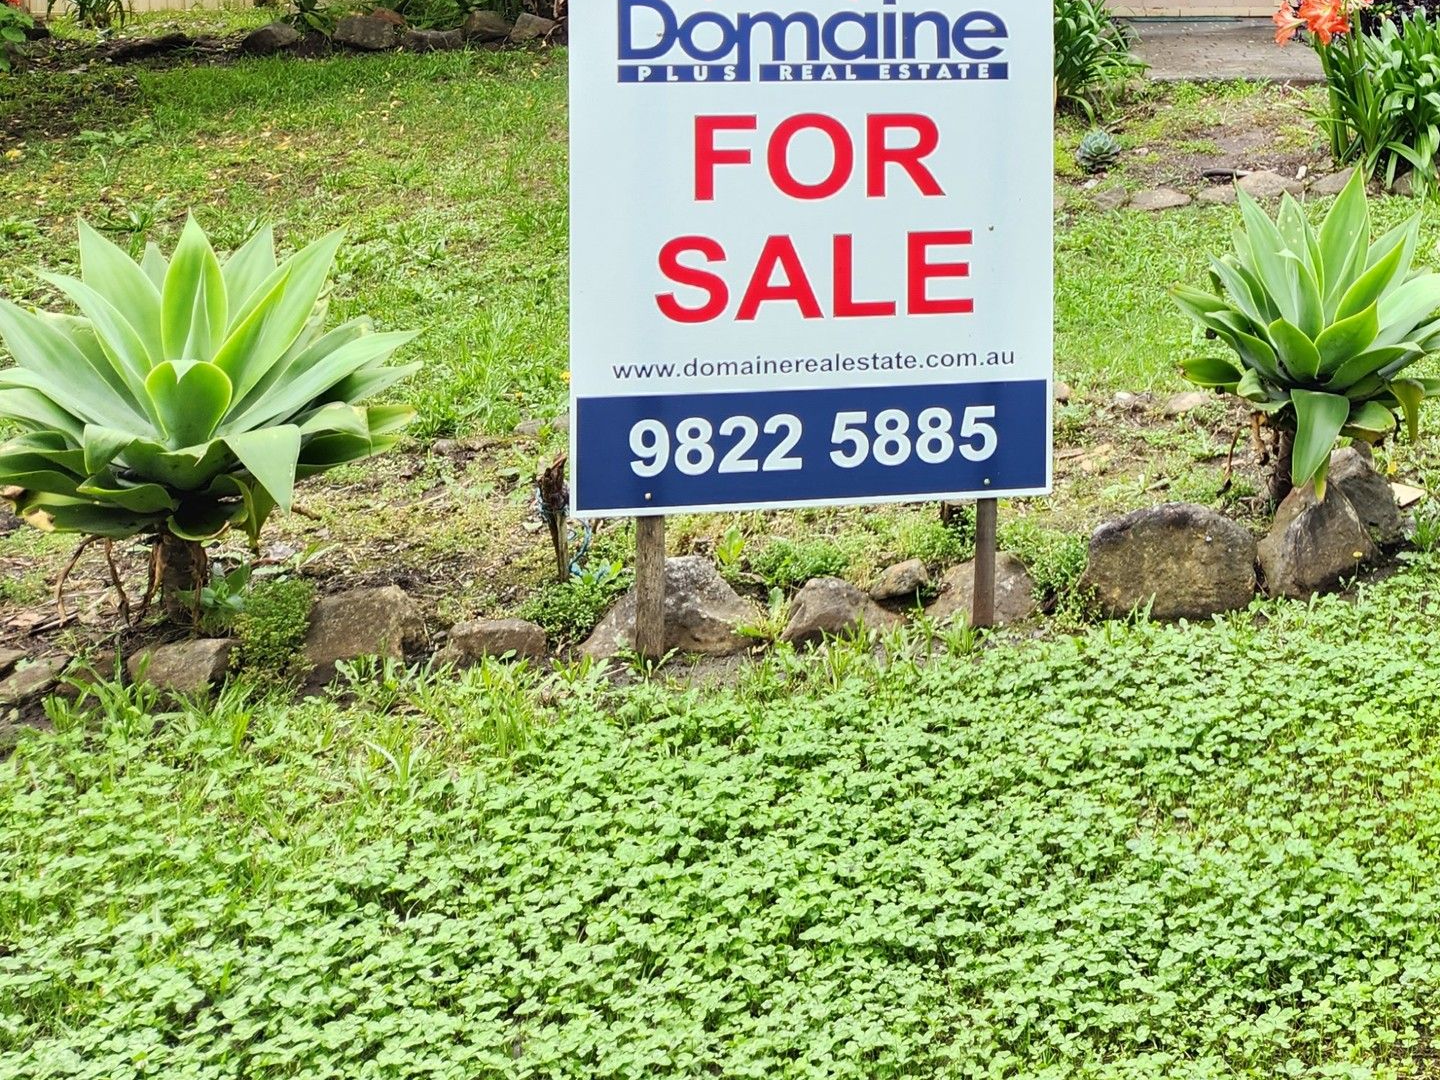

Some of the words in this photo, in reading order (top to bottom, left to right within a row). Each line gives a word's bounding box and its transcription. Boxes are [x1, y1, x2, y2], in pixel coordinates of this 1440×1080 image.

[637, 66, 737, 82] PLUS
[779, 66, 858, 80] REAL
[879, 64, 990, 79] ESTATE
[693, 112, 947, 201] FOR
[655, 229, 974, 323] SALE
[612, 348, 1016, 380] www.domainerealestate.com.au
[628, 413, 803, 478] 9822
[829, 405, 998, 468] 5885
